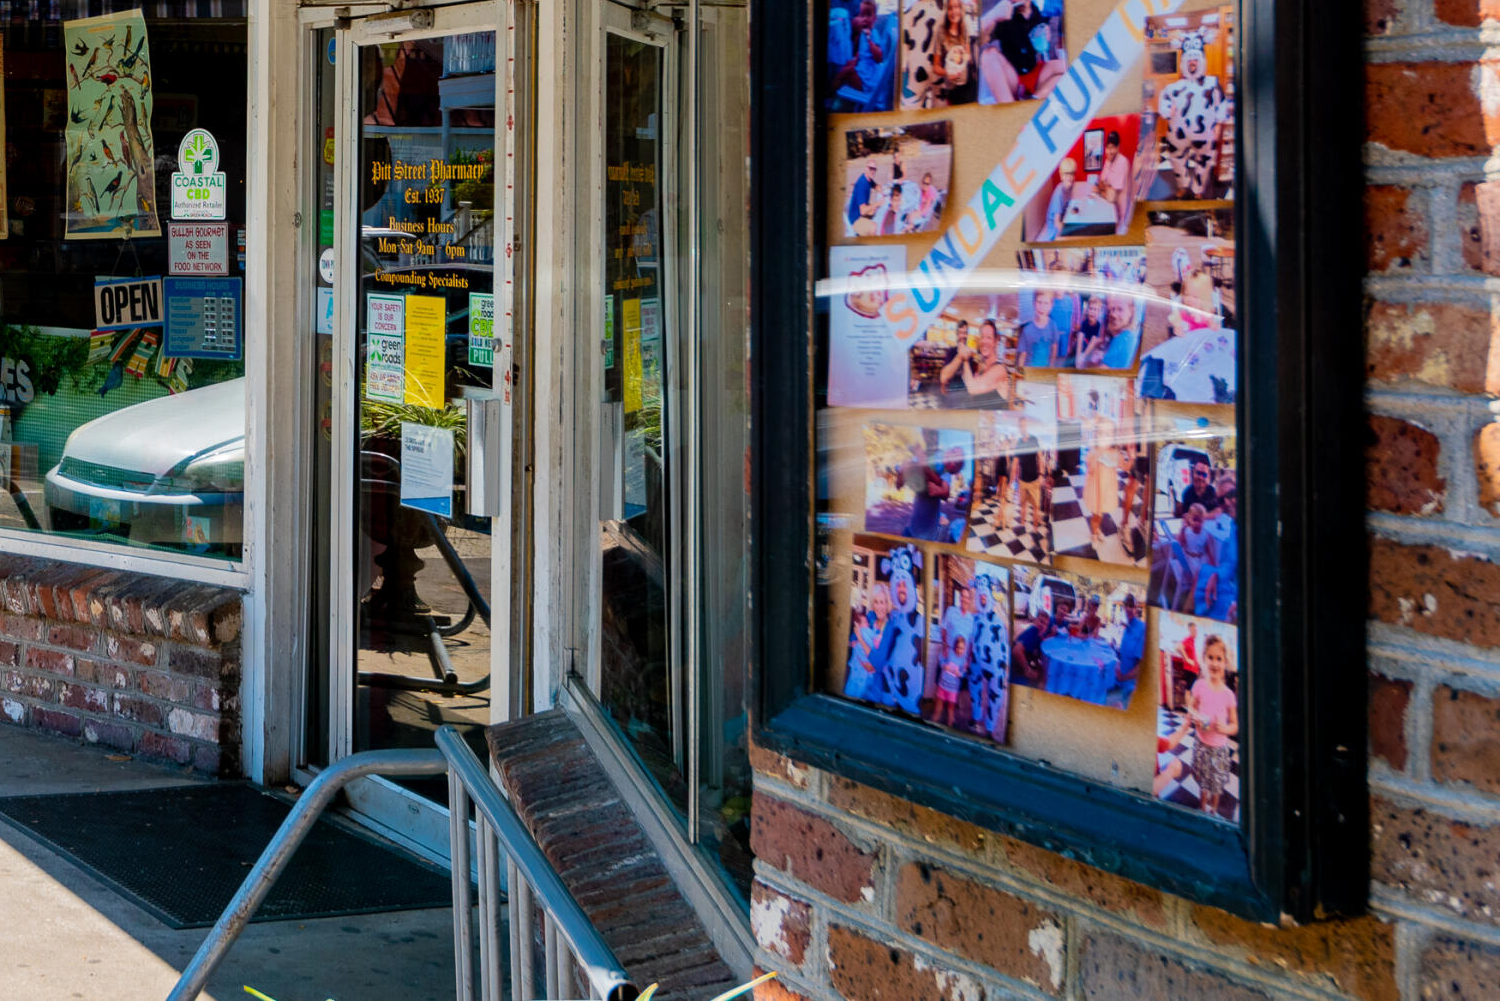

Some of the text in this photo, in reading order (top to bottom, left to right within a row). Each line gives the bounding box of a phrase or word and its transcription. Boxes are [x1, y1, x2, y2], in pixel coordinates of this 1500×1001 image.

[372, 159, 484, 185] Pitt Street Pharmacy
[174, 176, 223, 187] COASTAL
[886, 141, 1037, 340] SUNDAE
[1031, 30, 1122, 154] FUN
[186, 188, 211, 200] CBD
[404, 187, 445, 204] Est. 1937
[389, 216, 455, 233] Business Hours
[185, 240, 211, 249] AS SEEN
[416, 239, 435, 255] 9am
[445, 241, 466, 259] 6pm
[187, 251, 210, 260] ON THE
[174, 262, 223, 271] FOOD NETWORK
[375, 268, 469, 289] Compounding Specialists
[100, 282, 159, 325] OPEN
[481, 300, 494, 309] gree
[381, 339, 401, 352] green
[381, 352, 401, 365] roads
